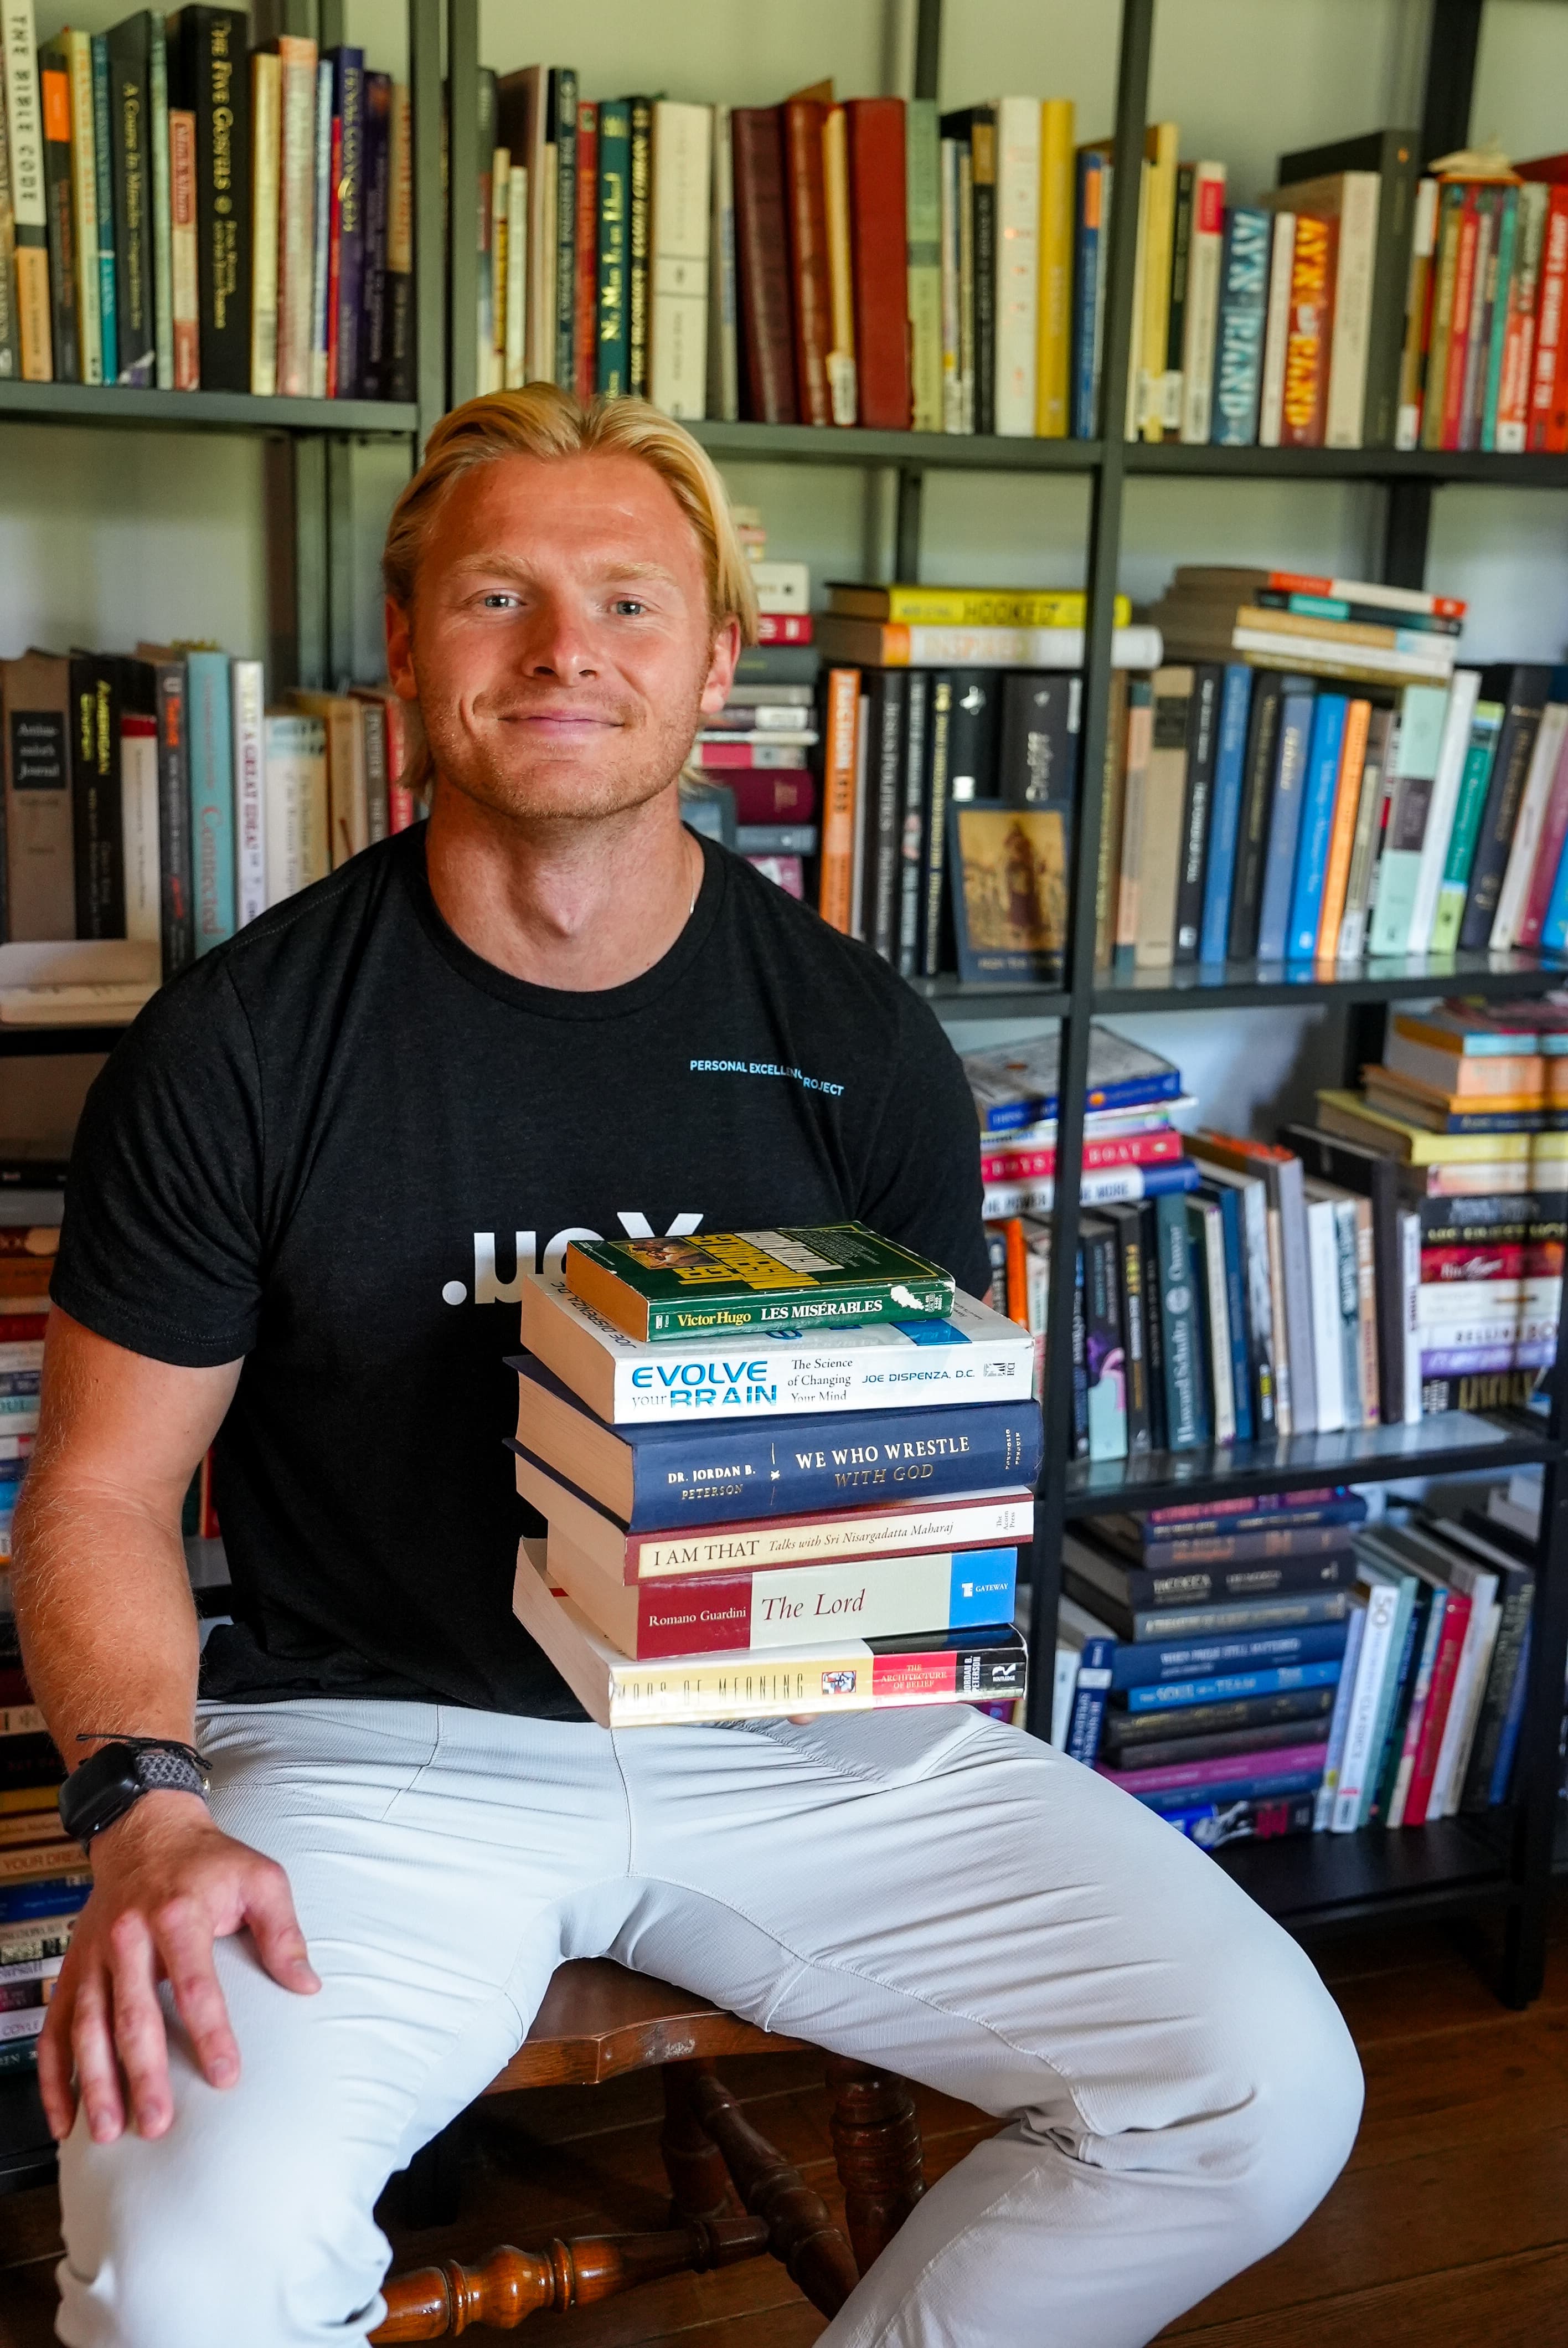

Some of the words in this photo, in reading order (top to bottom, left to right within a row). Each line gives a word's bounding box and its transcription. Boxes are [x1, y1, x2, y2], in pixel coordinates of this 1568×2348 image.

[15, 70, 33, 132] BIBLE
[19, 146, 37, 202] CODE
[1227, 211, 1268, 292] AYN
[1292, 217, 1328, 292] AYN
[1218, 310, 1259, 417] RAND
[1284, 334, 1319, 426] RAND
[690, 1060, 747, 1073] PERSONAL
[749, 1063, 803, 1080] EXCELLEN
[803, 1077, 844, 1096] ROJECT
[733, 1230, 807, 1249] HUGO
[759, 1247, 845, 1273] VICTOR
[670, 1264, 746, 1284] LES
[678, 1313, 716, 1327] Victor
[717, 1311, 752, 1327] Hugo
[761, 1306, 789, 1321] LES
[791, 1300, 883, 1319] MISÉRABLES
[608, 1334, 637, 1348] JOE
[632, 1361, 768, 1388] EVOLVE
[791, 1359, 812, 1370] The
[814, 1358, 853, 1369] Science
[862, 1374, 886, 1384] JOE
[956, 1369, 976, 1378] D.C.
[787, 1374, 799, 1387] of
[801, 1374, 851, 1389] Changing
[631, 1395, 667, 1409] your
[669, 1384, 777, 1409] BRAIN
[791, 1392, 816, 1403] Your
[819, 1390, 847, 1402] Mind
[795, 1451, 827, 1470] WE
[831, 1446, 879, 1466] WHO
[884, 1436, 971, 1460] WRESTLE
[668, 1471, 688, 1484] DR.
[692, 1467, 740, 1482] JORDAN
[744, 1464, 756, 1476] B.
[834, 1469, 886, 1488] WITH
[893, 1463, 934, 1481] GOD
[682, 1484, 744, 1500] PETERSON
[654, 1551, 660, 1566] I
[666, 1547, 698, 1566] AM
[704, 1540, 760, 1560] THAT
[769, 1539, 796, 1552] Talks
[798, 1536, 821, 1549] with
[824, 1533, 840, 1546] Sri
[842, 1527, 909, 1544] Nisargadatta
[910, 1522, 954, 1537] Maharaj
[974, 1582, 1009, 1593] GATEWAY
[649, 1614, 697, 1626] Romano
[700, 1606, 746, 1622] Guardini
[762, 1595, 803, 1621] The
[814, 1589, 866, 1616] Lord
[964, 1655, 972, 1664] B.
[881, 1671, 947, 1682] ARCHITECTURE
[906, 1680, 935, 1688] BELIEF
[963, 1666, 972, 1693] JORDAN
[972, 1656, 981, 1693] PETERSON
